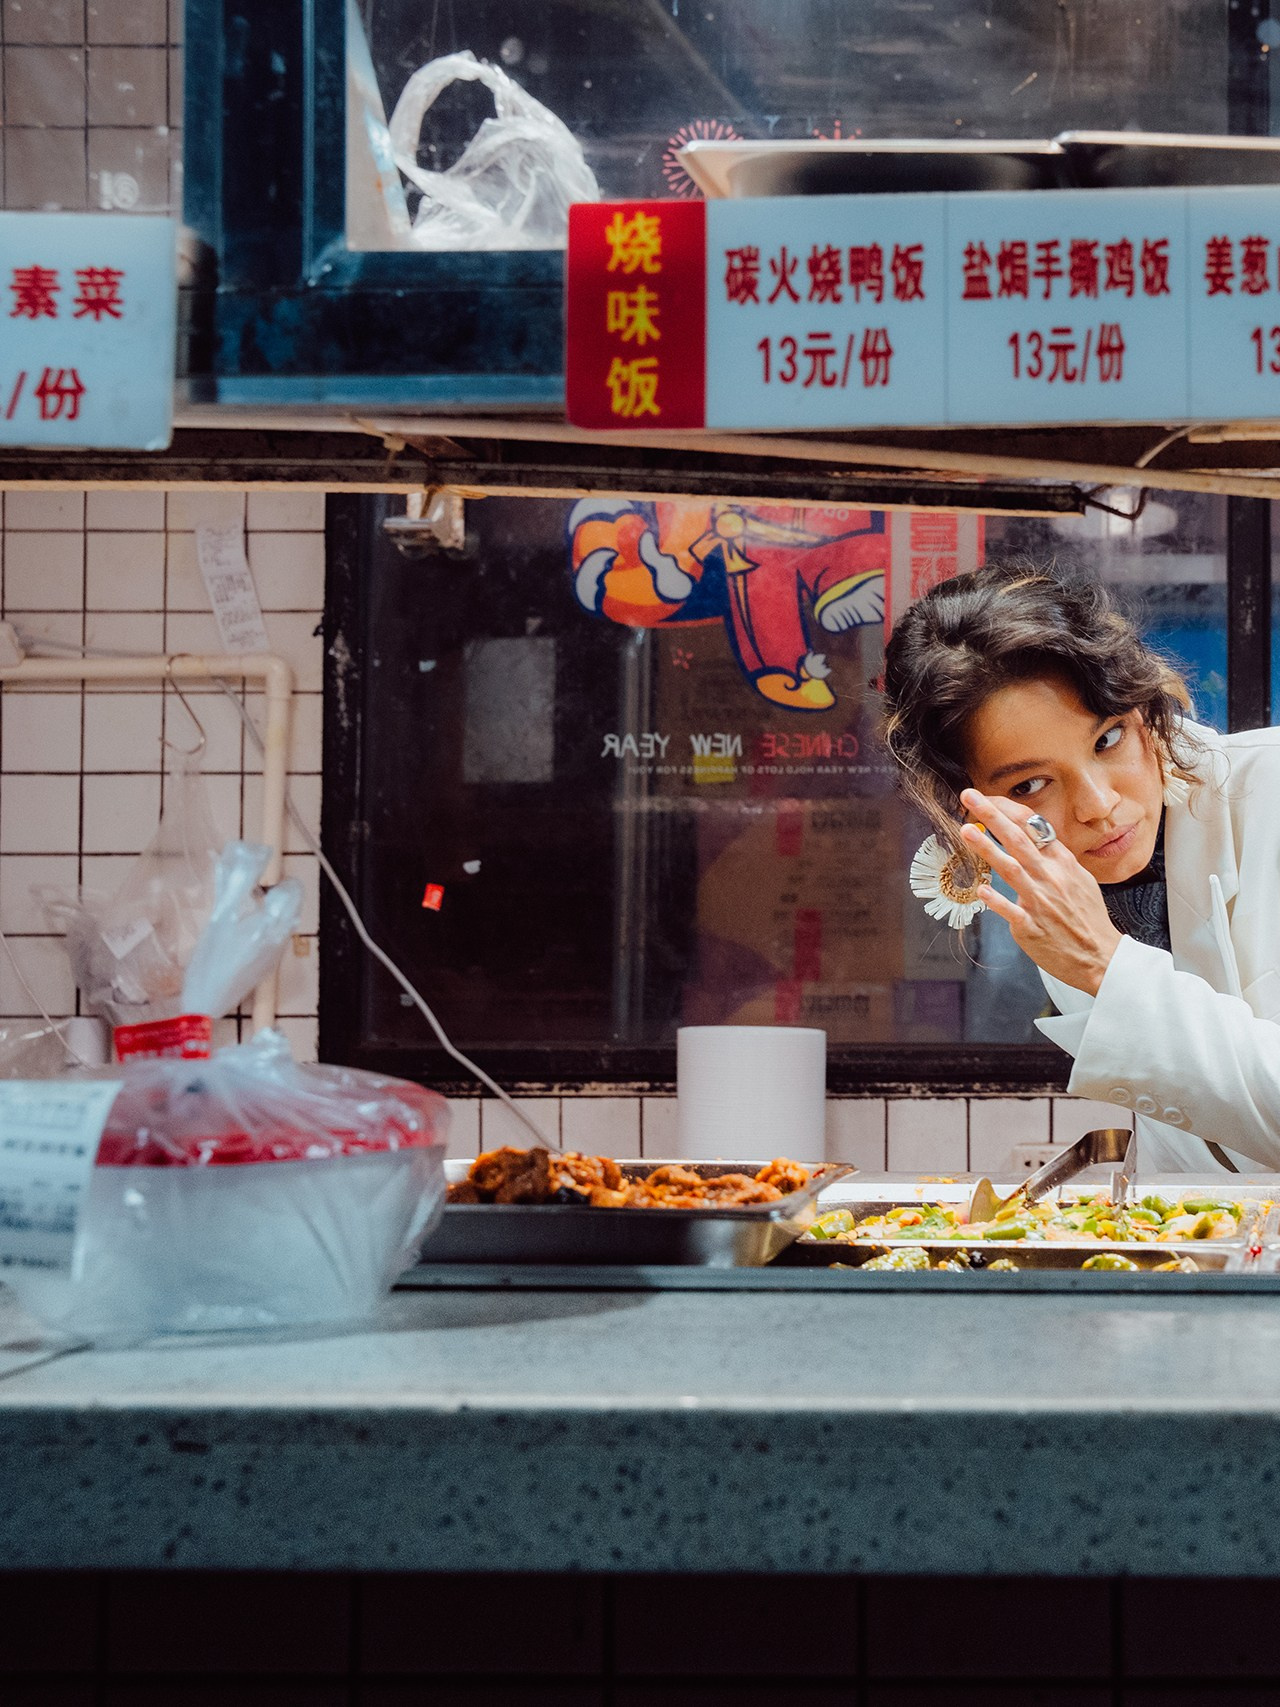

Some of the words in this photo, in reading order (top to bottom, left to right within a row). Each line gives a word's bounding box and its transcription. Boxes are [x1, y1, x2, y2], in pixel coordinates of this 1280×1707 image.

[10, 265, 124, 321] 素菜
[725, 243, 924, 304] 碳火烧鸭饭
[963, 238, 1170, 300] 盐焗手撕鸡饭
[607, 213, 660, 417] 烧味饭
[758, 327, 894, 388] 13元/份
[1008, 323, 1126, 383] 13元/份
